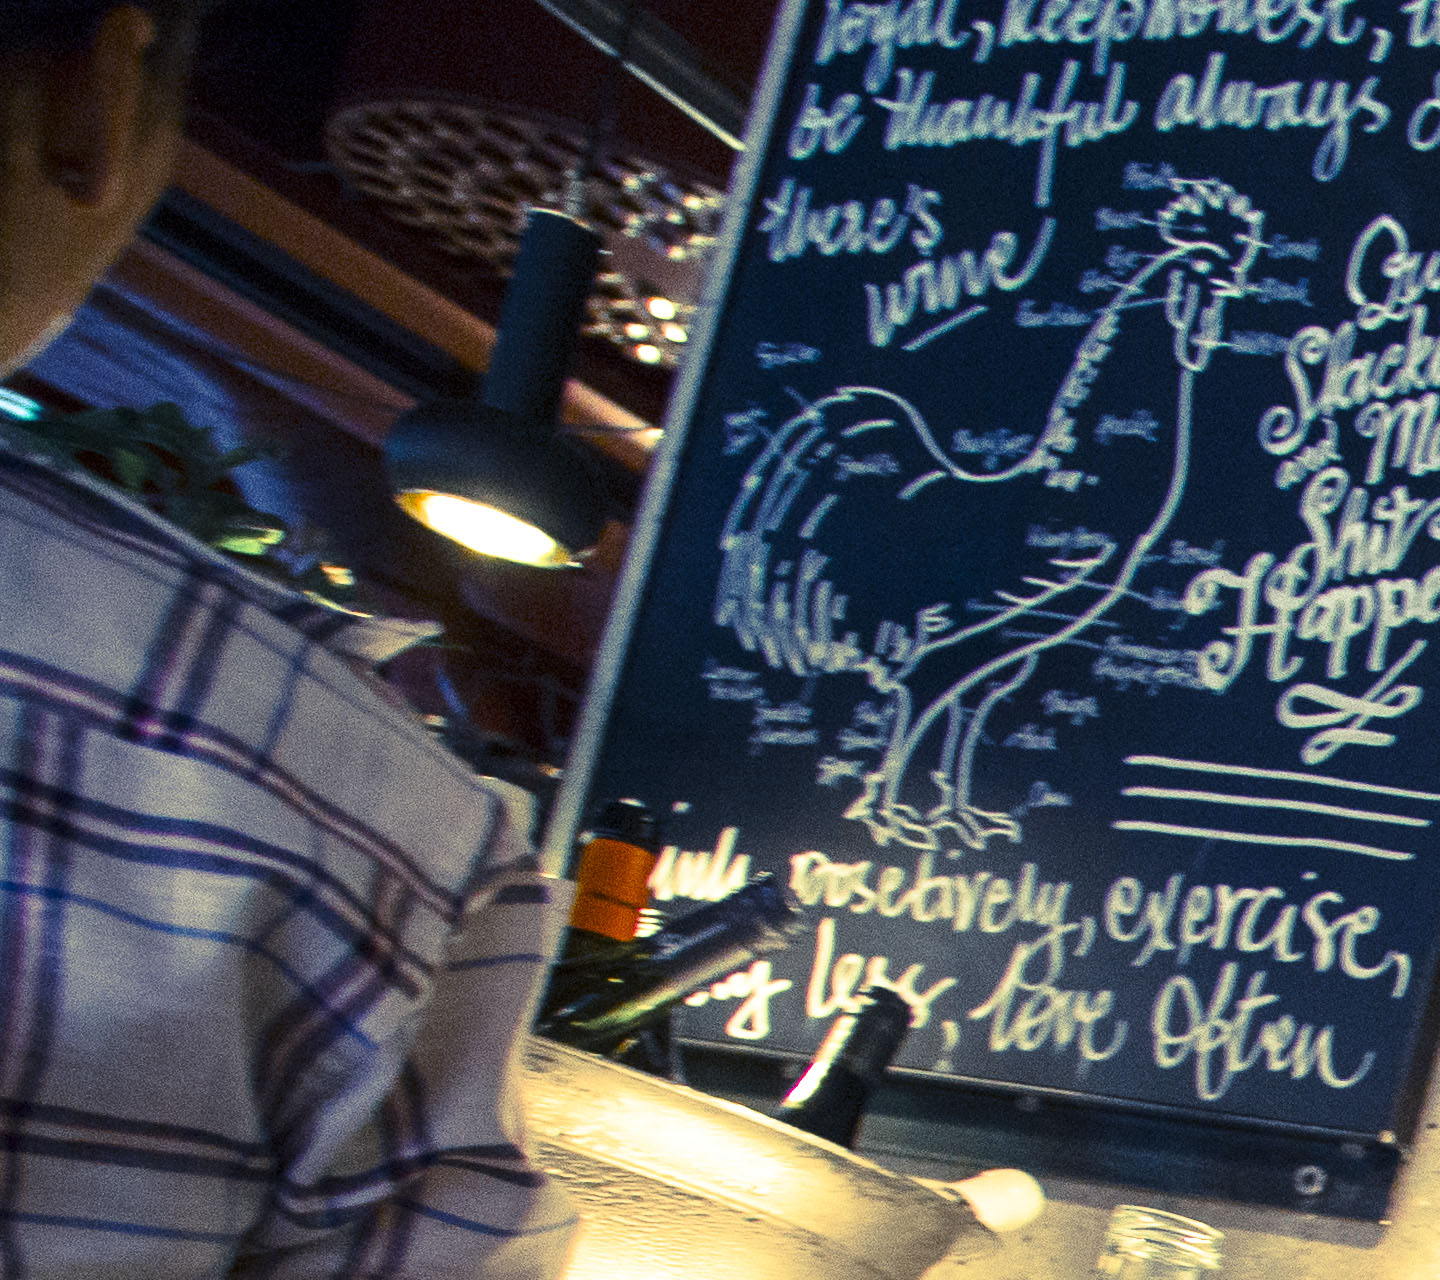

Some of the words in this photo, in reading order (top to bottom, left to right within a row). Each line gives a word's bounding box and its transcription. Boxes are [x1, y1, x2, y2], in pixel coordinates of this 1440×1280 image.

[788, 83, 865, 160] be
[873, 60, 1140, 208] thankful
[1153, 52, 1391, 182] always
[863, 217, 1057, 348] wine
[1103, 872, 1412, 999] exercise,
[968, 940, 1129, 1064] love
